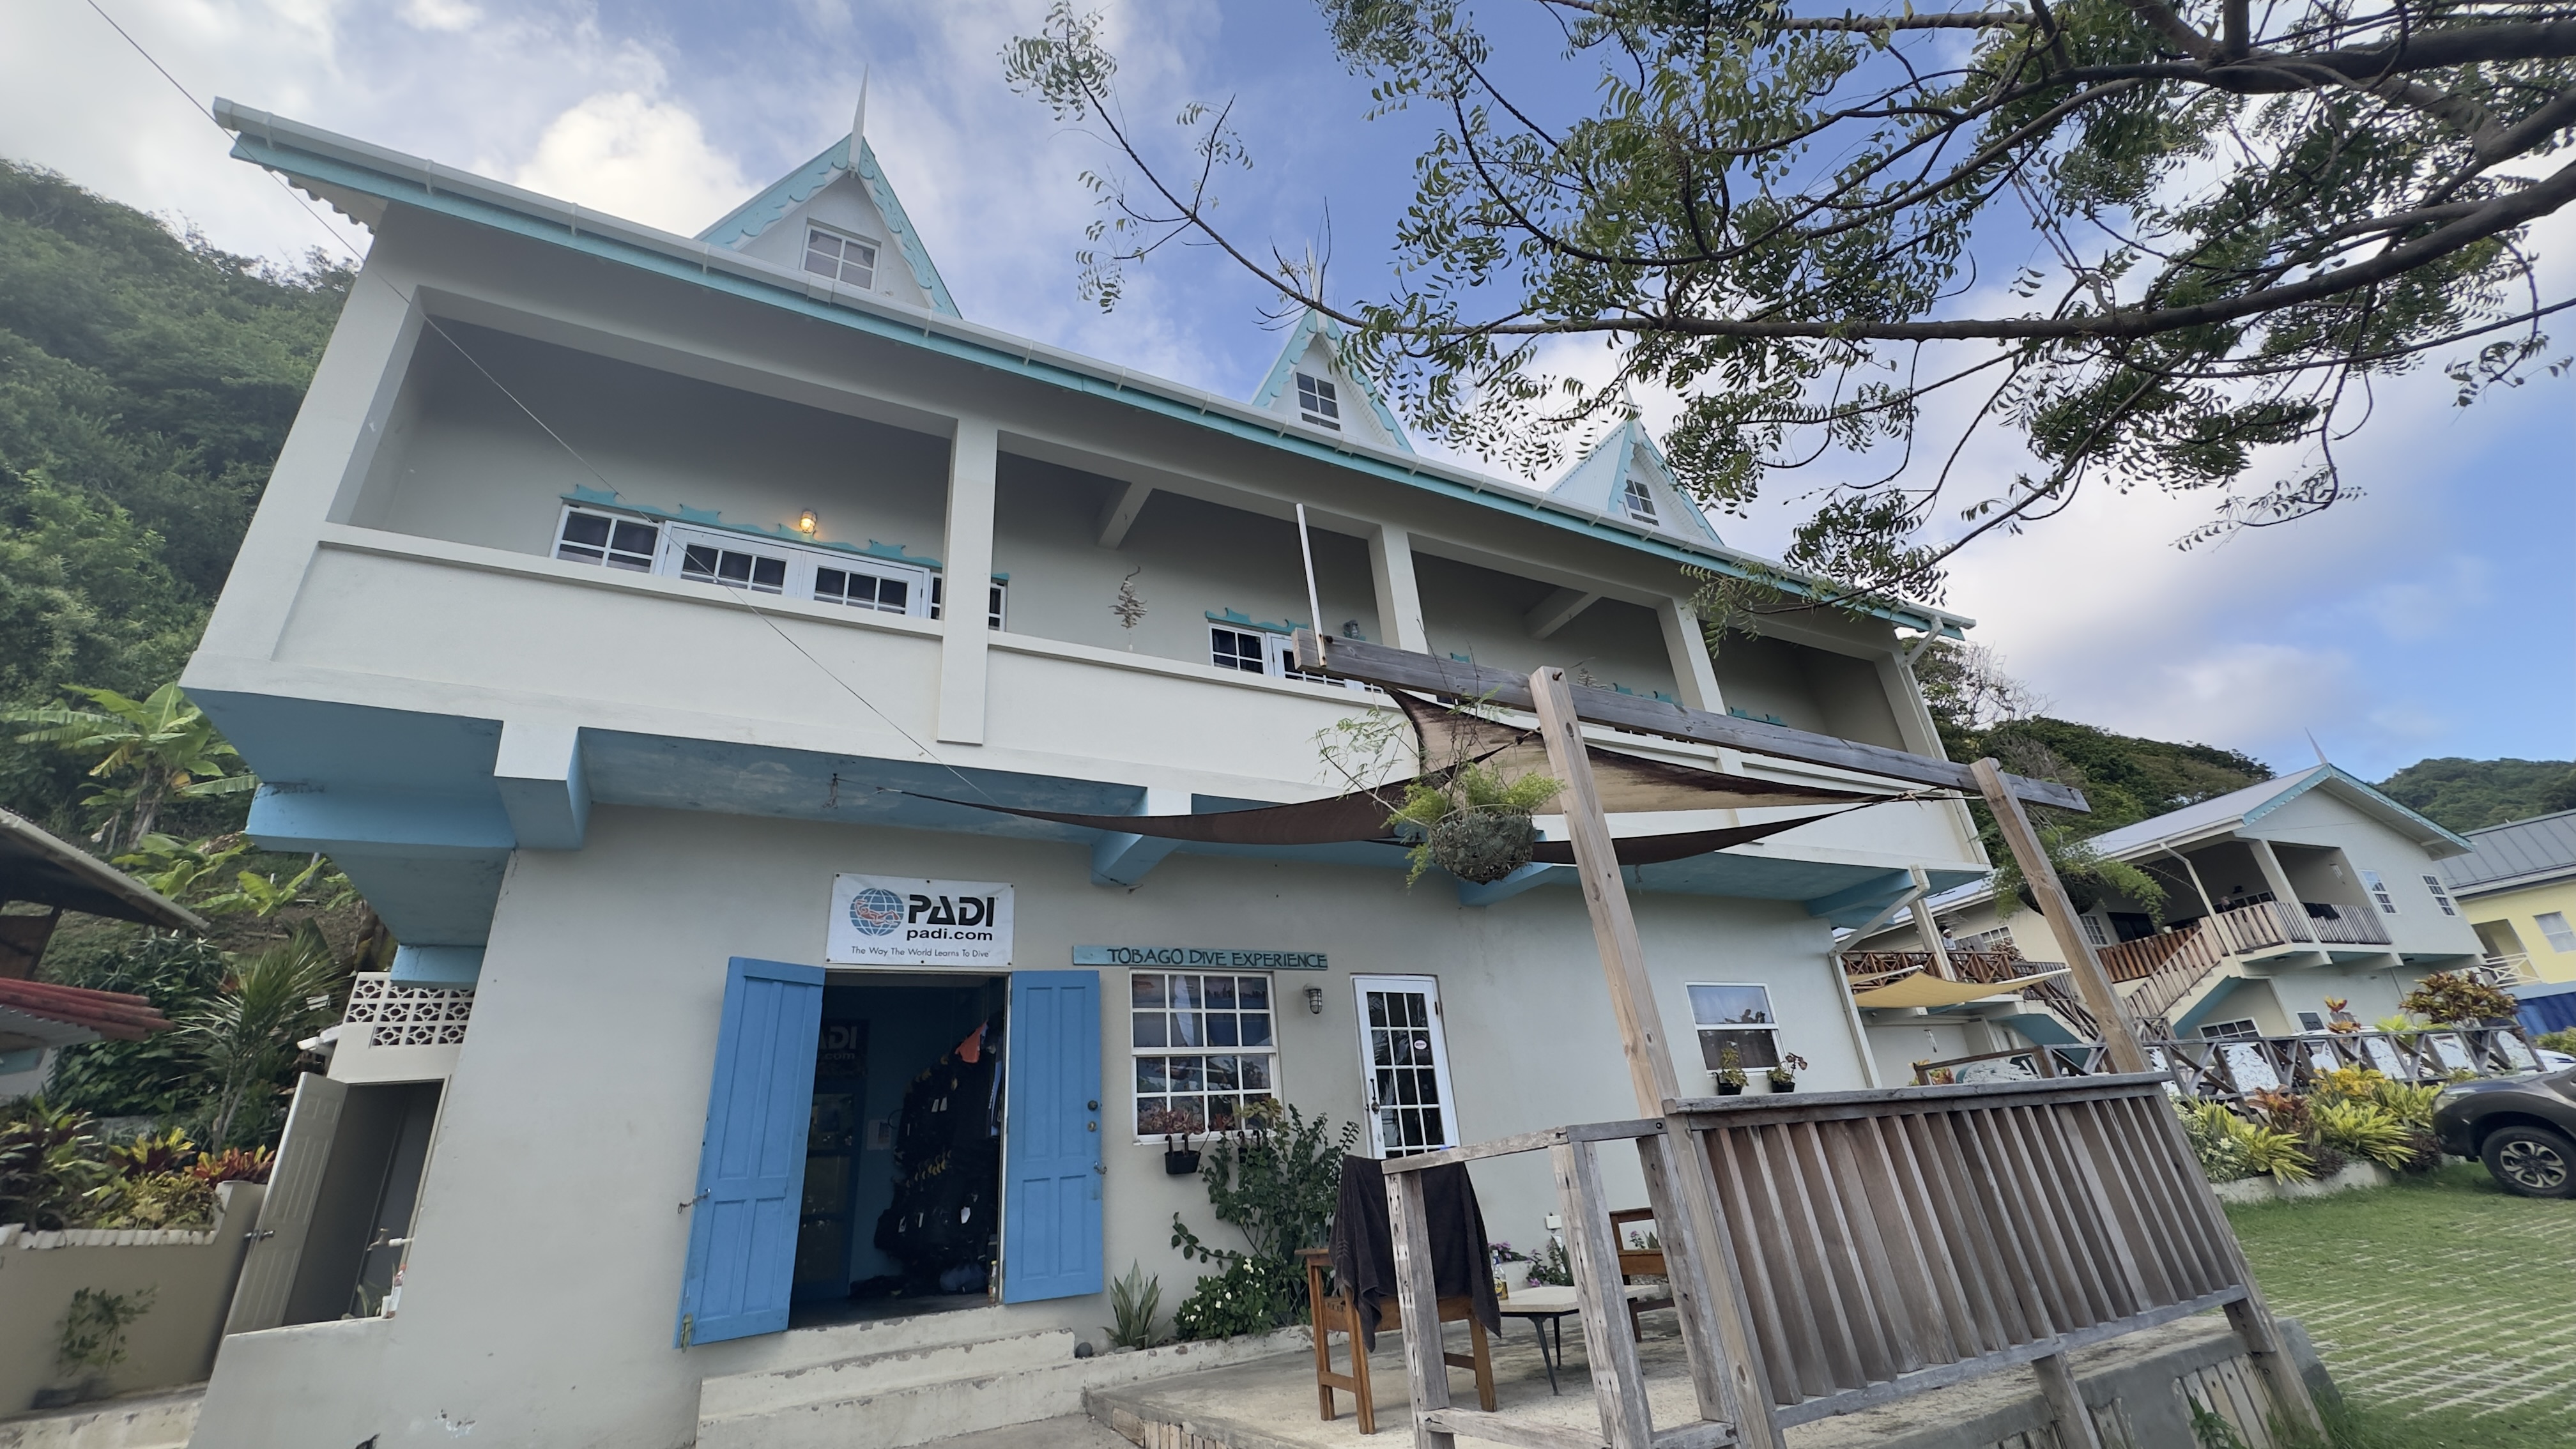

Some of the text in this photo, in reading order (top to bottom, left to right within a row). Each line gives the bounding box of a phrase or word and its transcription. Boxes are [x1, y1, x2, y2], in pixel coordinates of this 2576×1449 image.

[908, 894, 995, 928] PADI
[907, 928, 993, 941] padi.com
[852, 946, 866, 954] The
[869, 947, 887, 956] Way
[891, 947, 905, 956] The
[908, 948, 932, 956] World
[1107, 947, 1328, 969] TOBAGO DIVE EXPERIENCE
